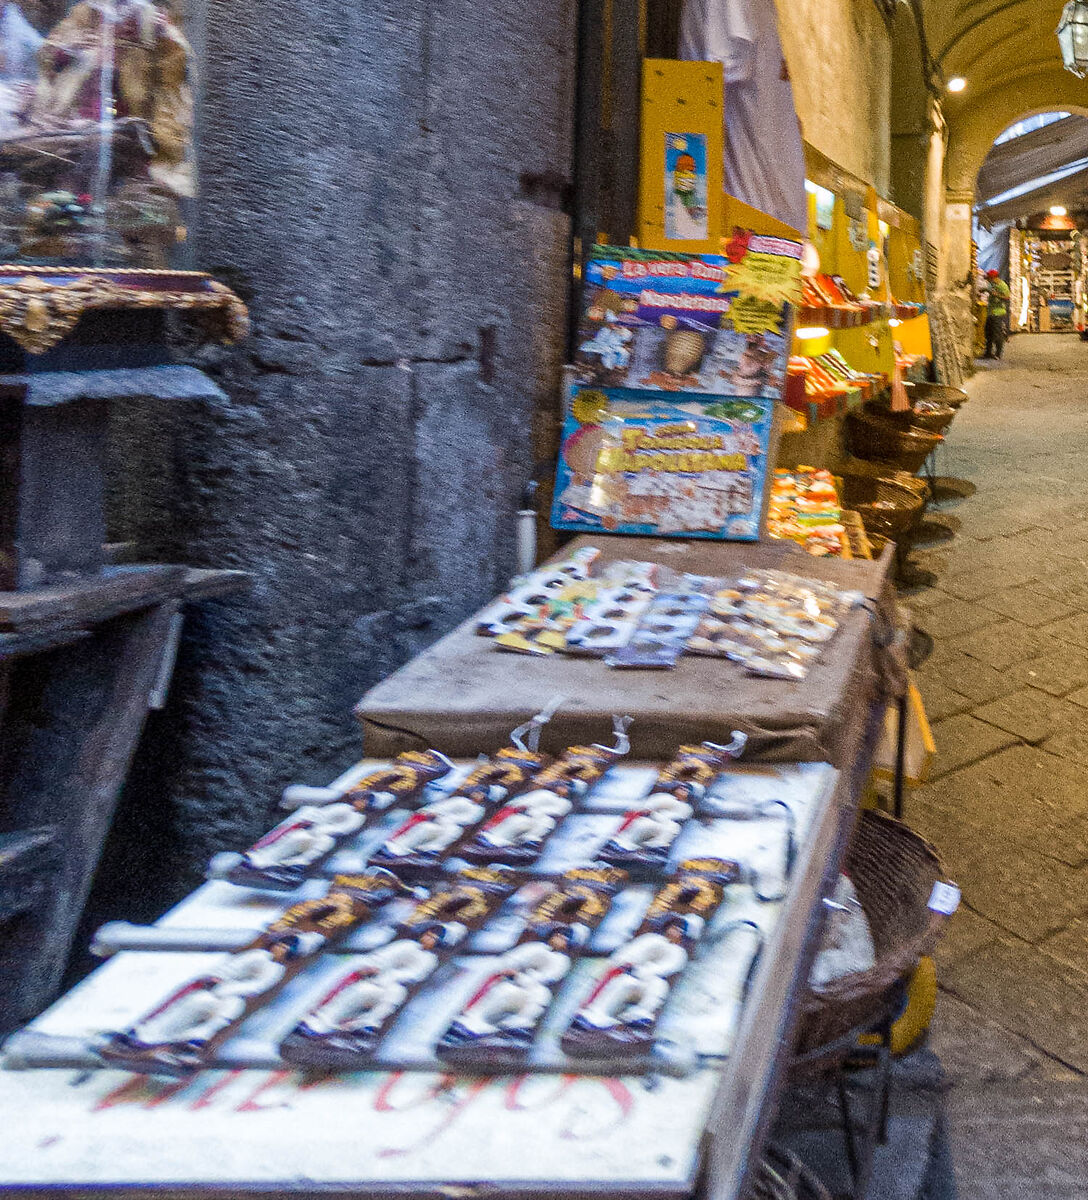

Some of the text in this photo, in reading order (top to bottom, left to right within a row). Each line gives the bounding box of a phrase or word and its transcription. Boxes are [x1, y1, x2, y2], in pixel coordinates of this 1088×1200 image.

[622, 260, 648, 278] La
[649, 261, 688, 278] vera
[689, 261, 729, 282] Tom
